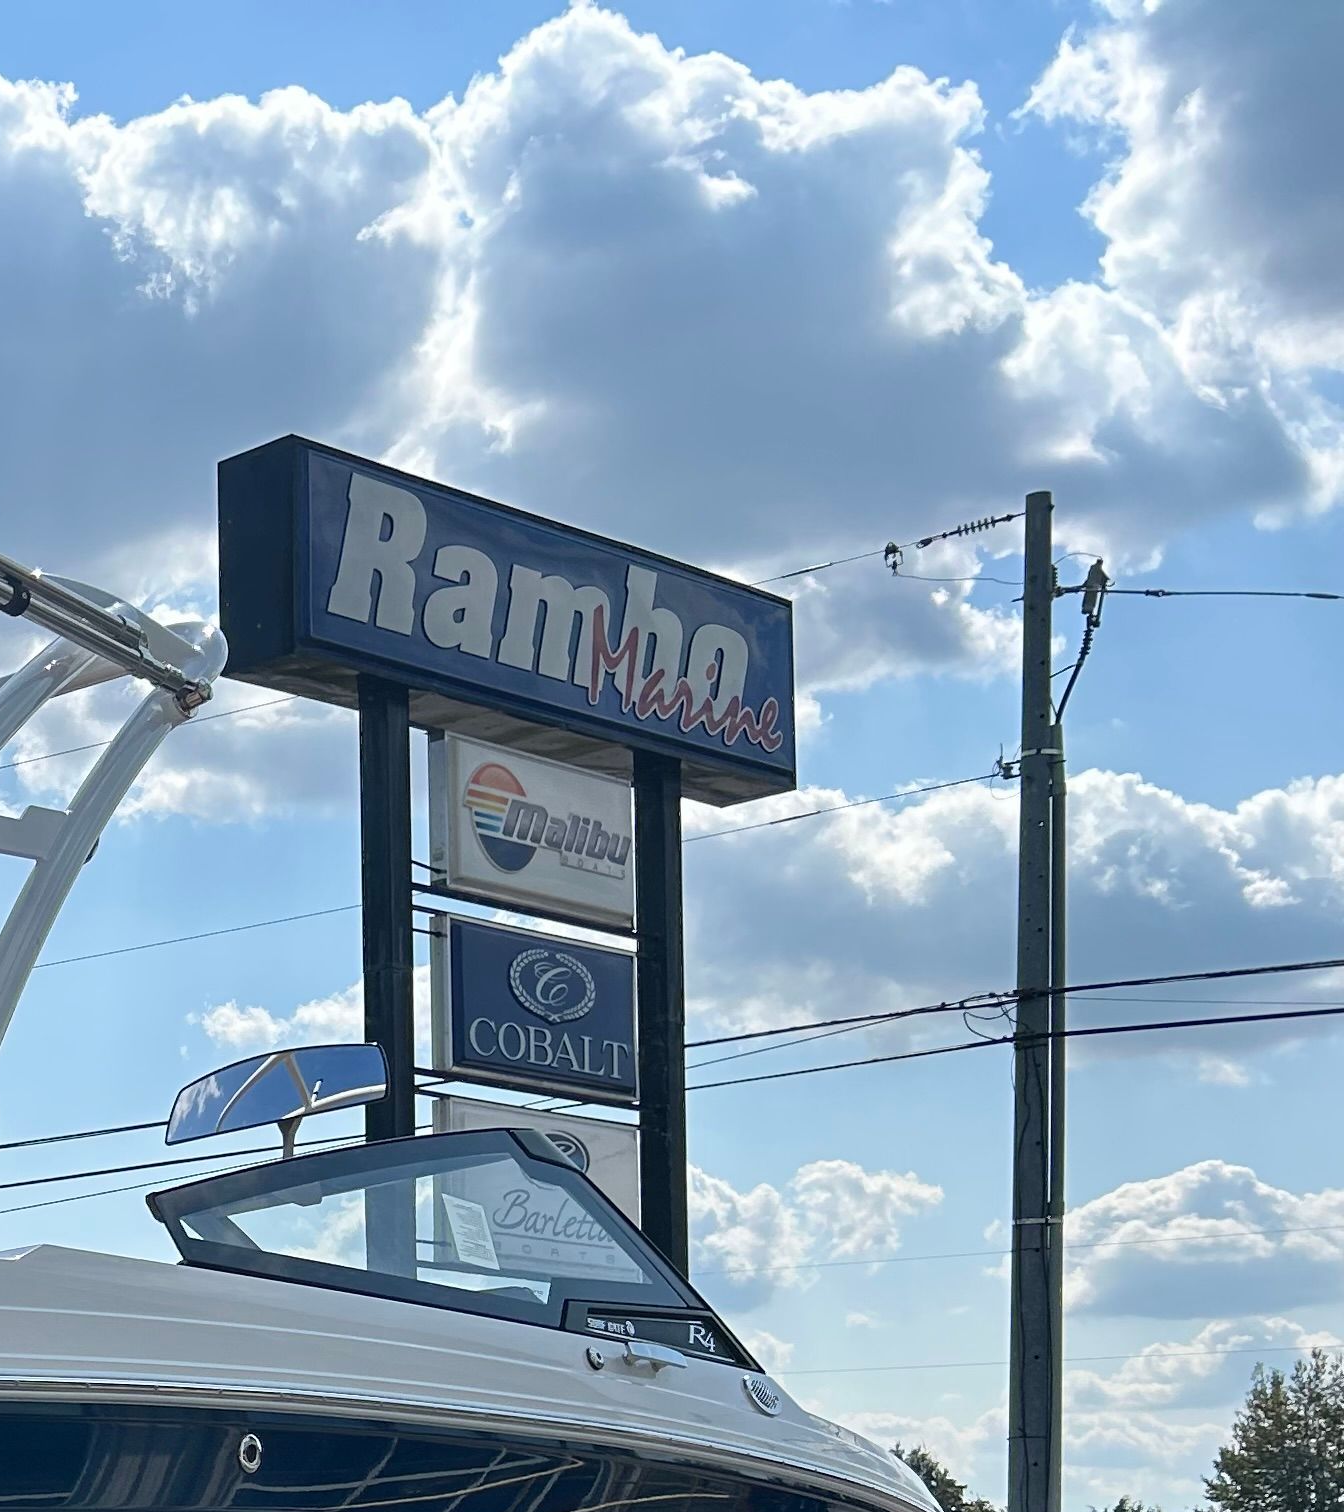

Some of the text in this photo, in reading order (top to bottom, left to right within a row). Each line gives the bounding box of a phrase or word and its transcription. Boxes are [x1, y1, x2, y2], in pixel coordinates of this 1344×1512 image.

[327, 472, 749, 716] Rambo
[590, 604, 783, 753] Marine
[501, 799, 631, 866] Malibu
[469, 1018, 629, 1080] COBALT
[688, 1323, 716, 1353] R4
